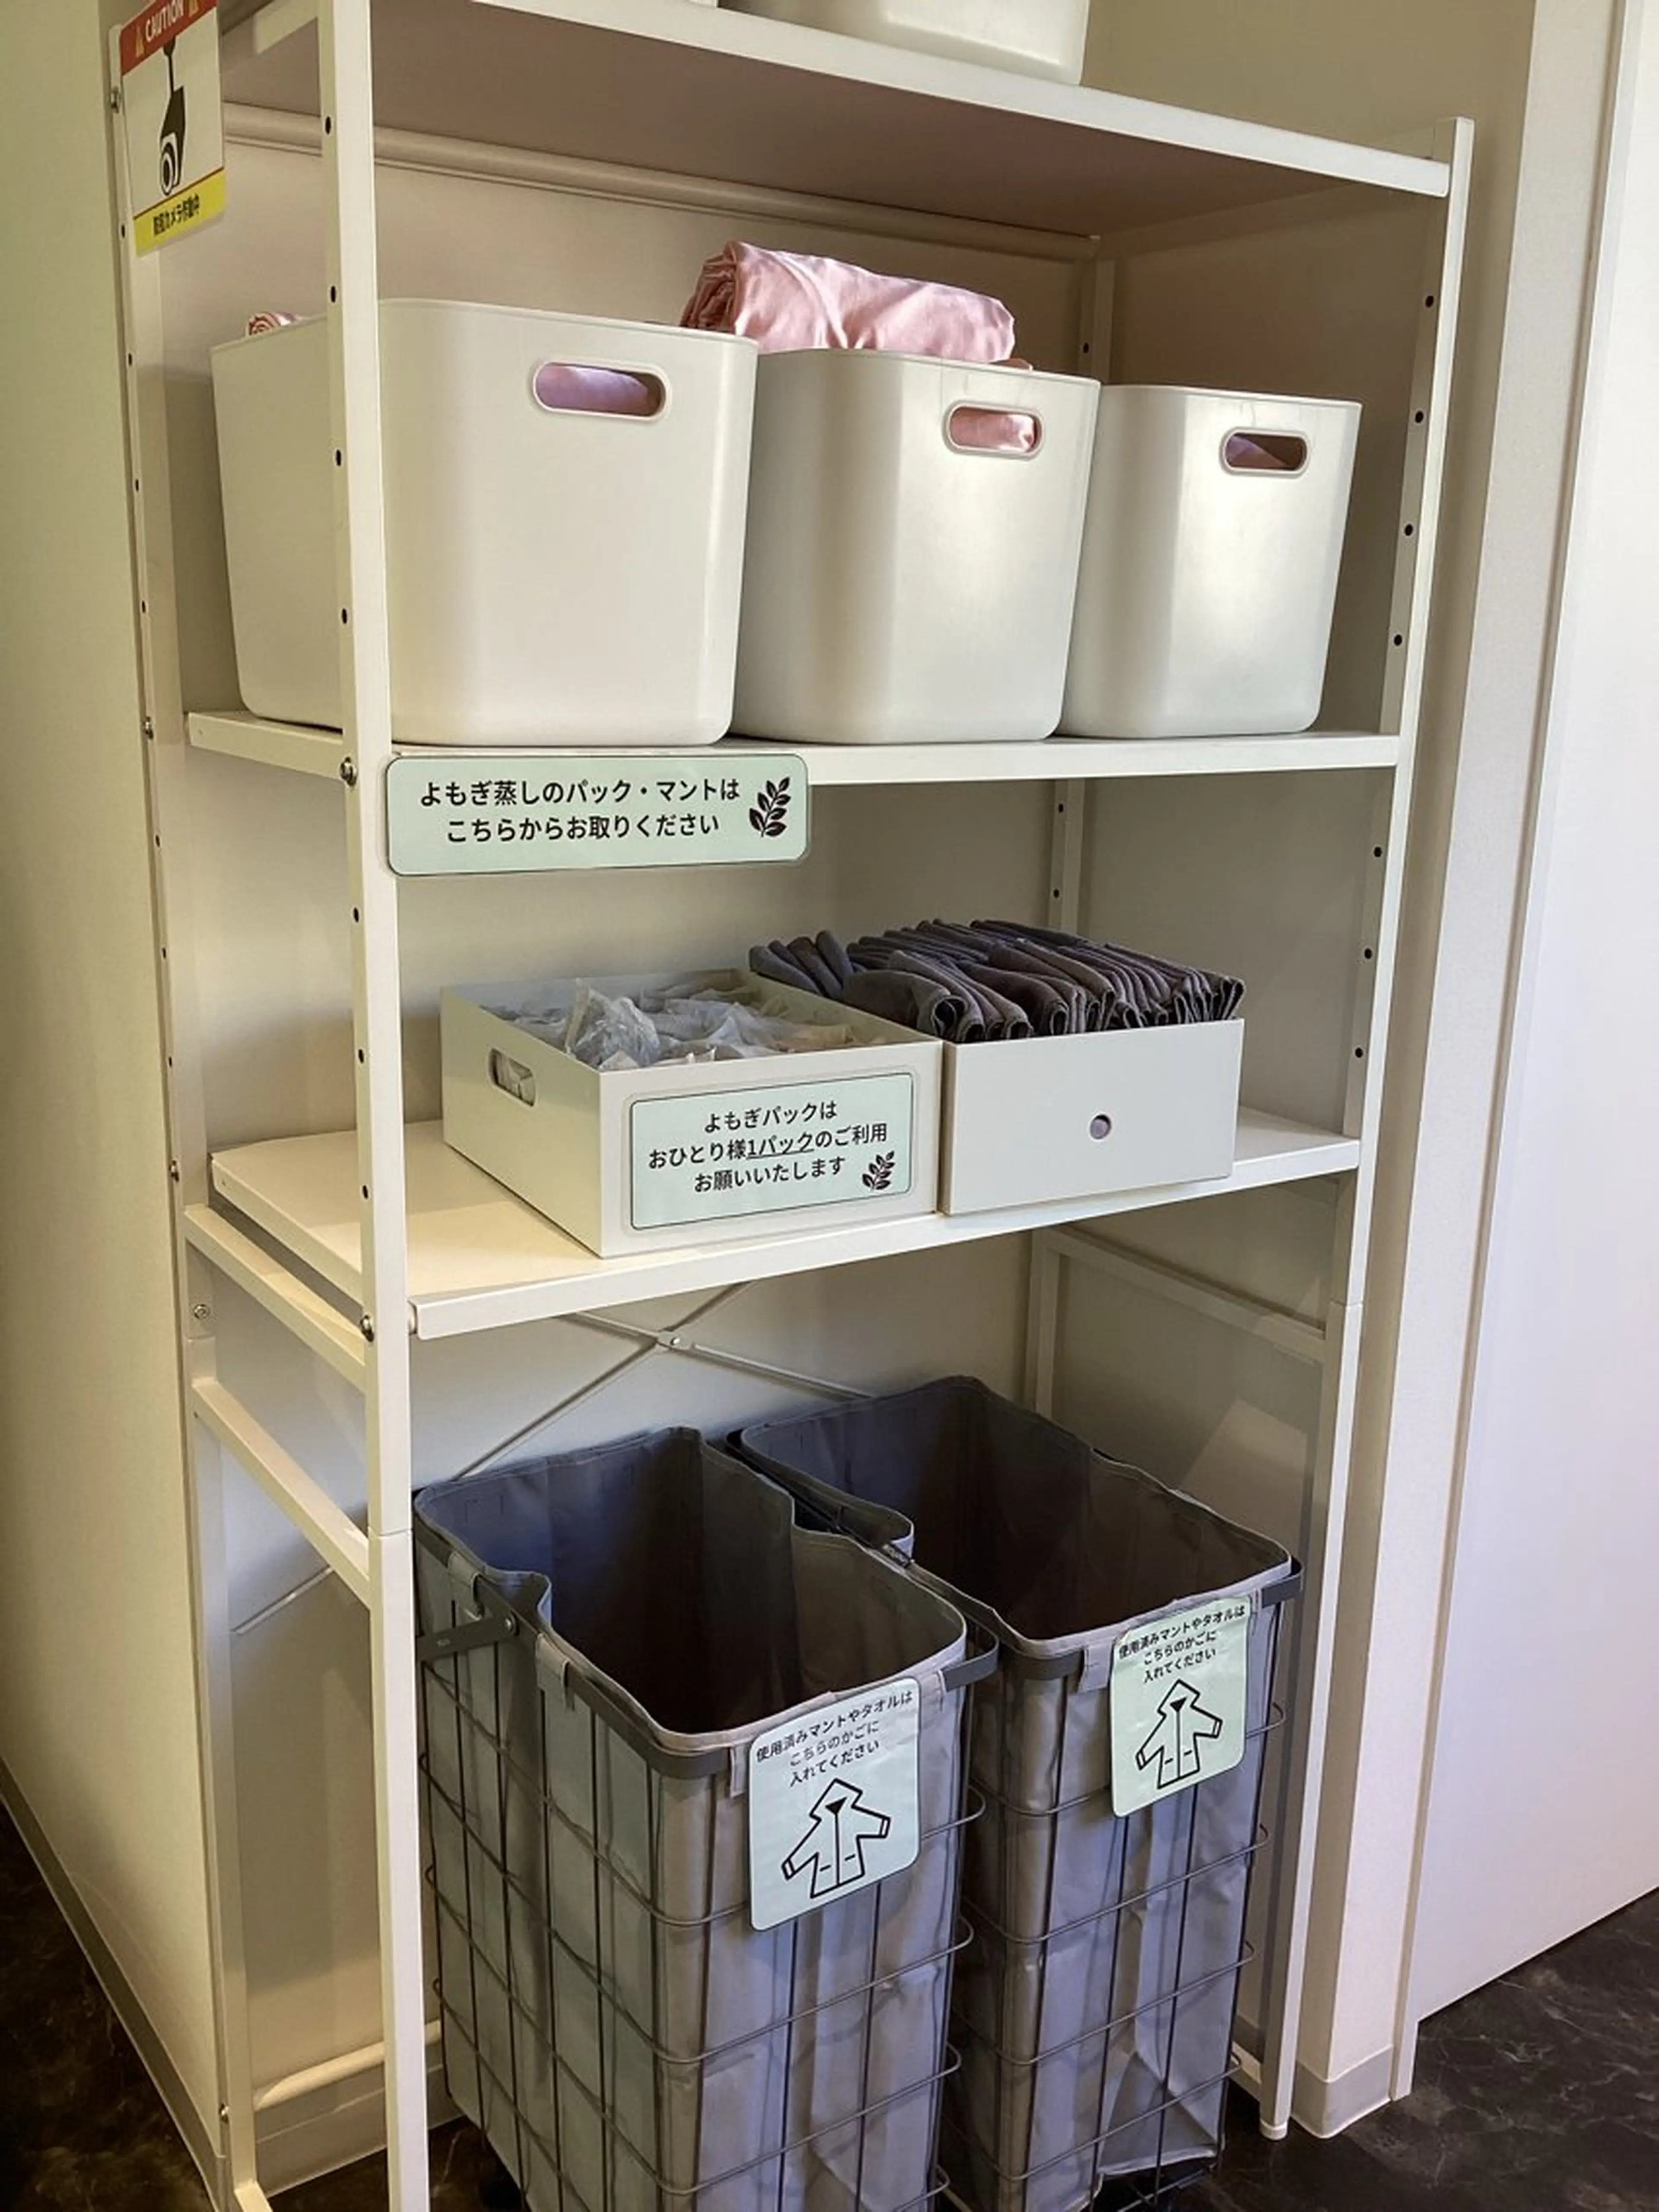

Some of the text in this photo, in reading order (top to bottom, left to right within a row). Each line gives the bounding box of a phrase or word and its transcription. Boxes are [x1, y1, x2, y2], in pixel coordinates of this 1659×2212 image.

[145, 0, 184, 42] CAUTION
[420, 778, 740, 807] よもぎ蒸しのパック・マントは
[447, 814, 719, 842] こちらからお取りください
[705, 1101, 837, 1133] よもぎパックは
[649, 1123, 887, 1168] おひとり様1パックのご利用
[694, 1157, 845, 1192] お願いいたします
[1119, 1605, 1245, 1659] 使用済みマントやタオルは
[1144, 1630, 1217, 1665] こちらのかごに
[1144, 1649, 1216, 1684] 入れてください
[756, 1691, 912, 1762] 使用済みマントやタオルは
[790, 1720, 880, 1766] こちらのかごに
[790, 1740, 880, 1787] 入れてください
